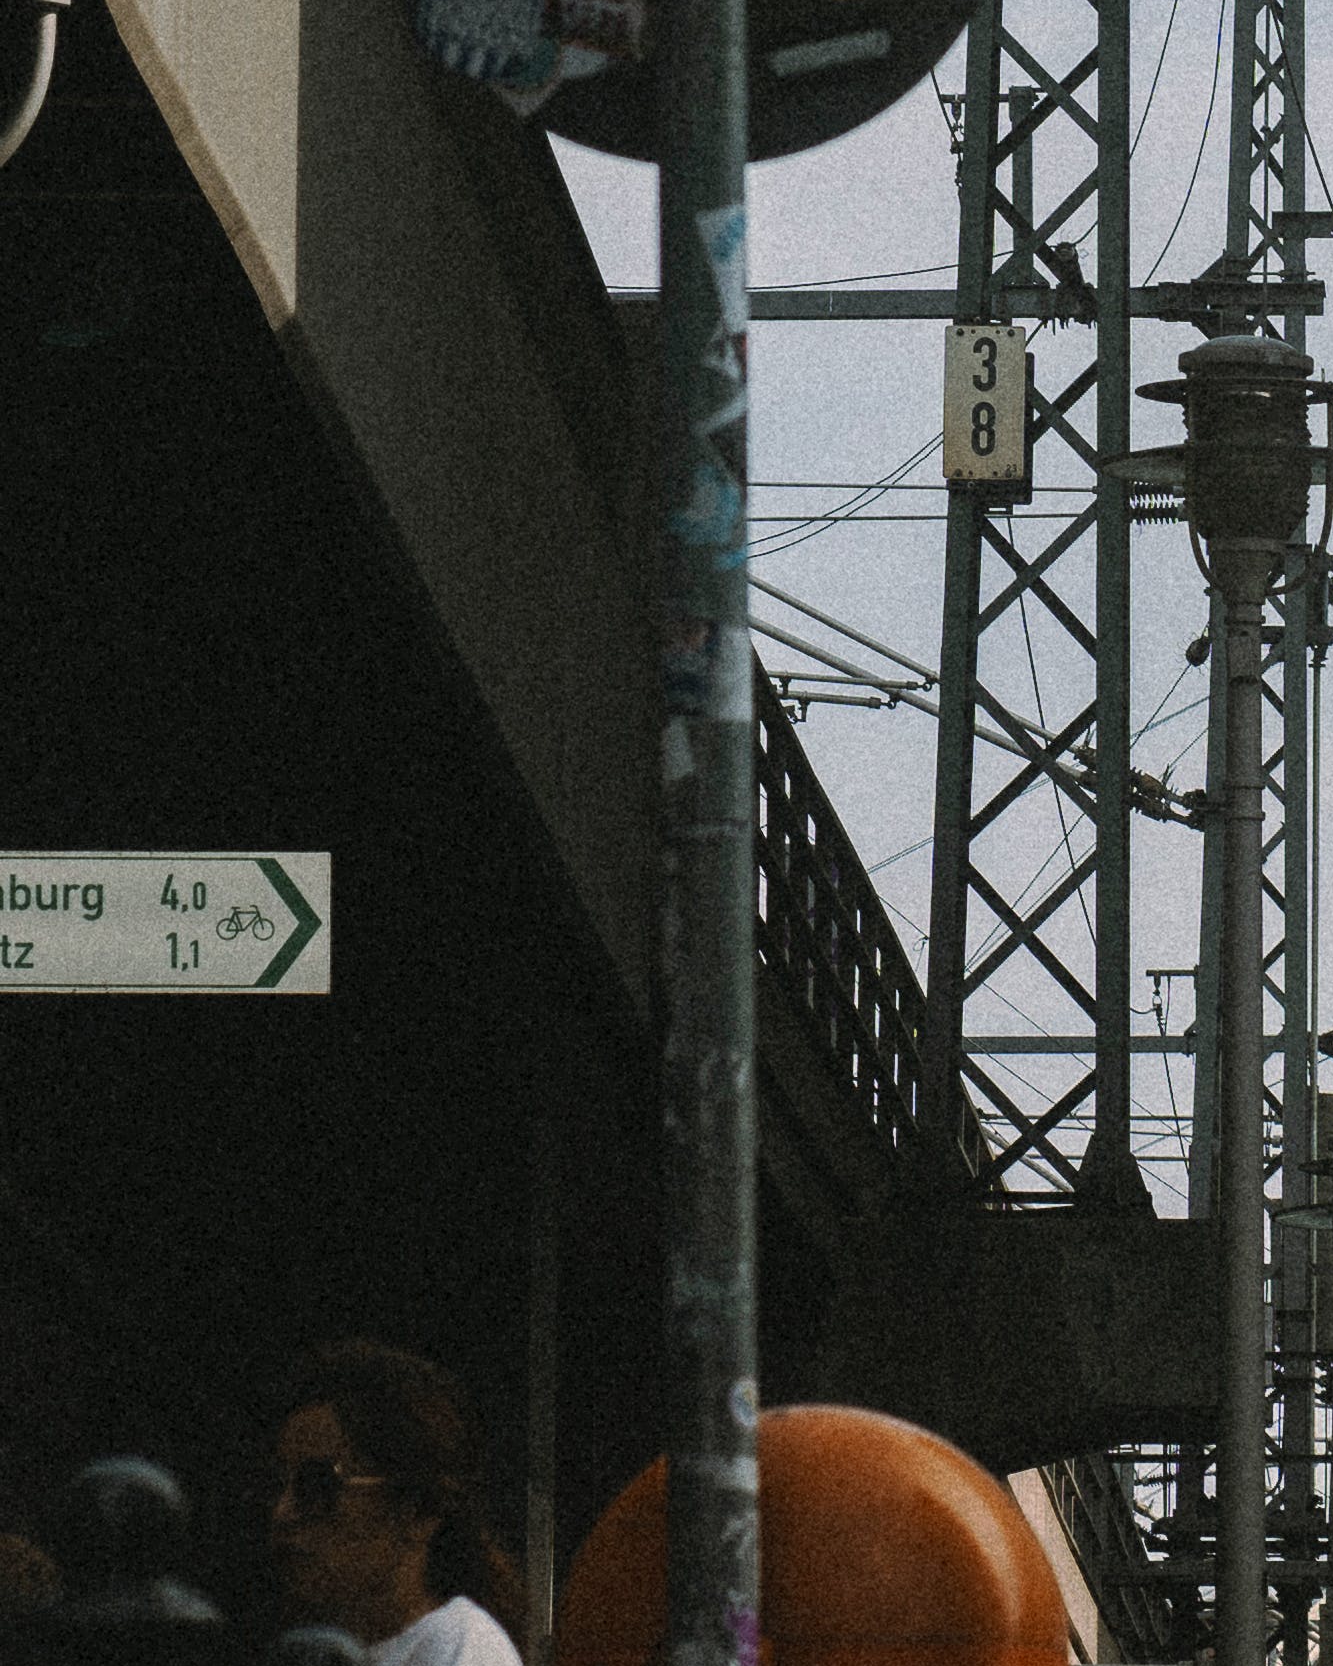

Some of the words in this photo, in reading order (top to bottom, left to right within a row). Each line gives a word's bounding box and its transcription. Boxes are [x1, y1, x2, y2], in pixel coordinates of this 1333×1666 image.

[0, 874, 104, 921] burg
[161, 874, 206, 913] 4,0
[166, 932, 199, 971] 1,1
